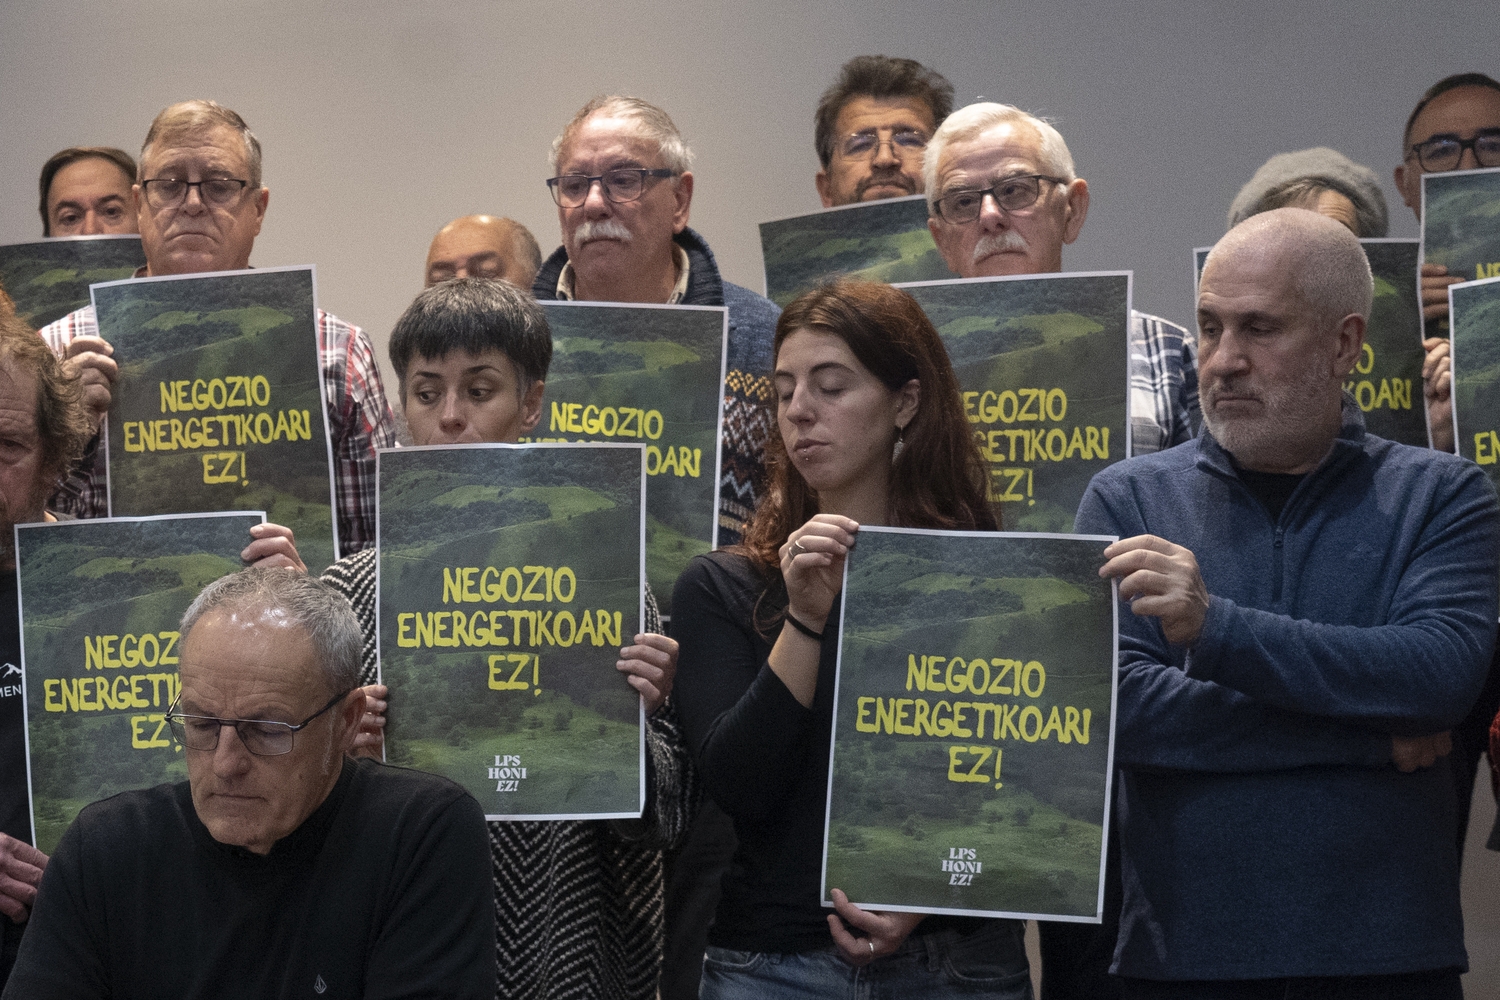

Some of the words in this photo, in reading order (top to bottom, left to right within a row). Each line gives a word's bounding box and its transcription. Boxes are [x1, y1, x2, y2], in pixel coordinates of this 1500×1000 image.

[160, 375, 271, 412] NEGOZIO
[963, 388, 1067, 423] EGOZIO
[124, 410, 311, 452] ENERGETIKOARI
[550, 402, 663, 439] NEGOZIO
[202, 452, 249, 487] EZ!
[442, 566, 576, 604] NEGOZIO
[397, 609, 623, 648] ENERGETIKOARI
[487, 654, 542, 696] EZ!
[905, 654, 1046, 698] NEGOZIO
[855, 697, 1091, 745] ENERGETIKOARI
[488, 767, 527, 779] HONI
[494, 755, 521, 766] LPS
[948, 746, 1003, 790] EZ!
[496, 780, 519, 792] EZ!
[942, 860, 982, 873] HONI
[949, 847, 977, 860] LPS
[949, 874, 974, 886] EZ!
